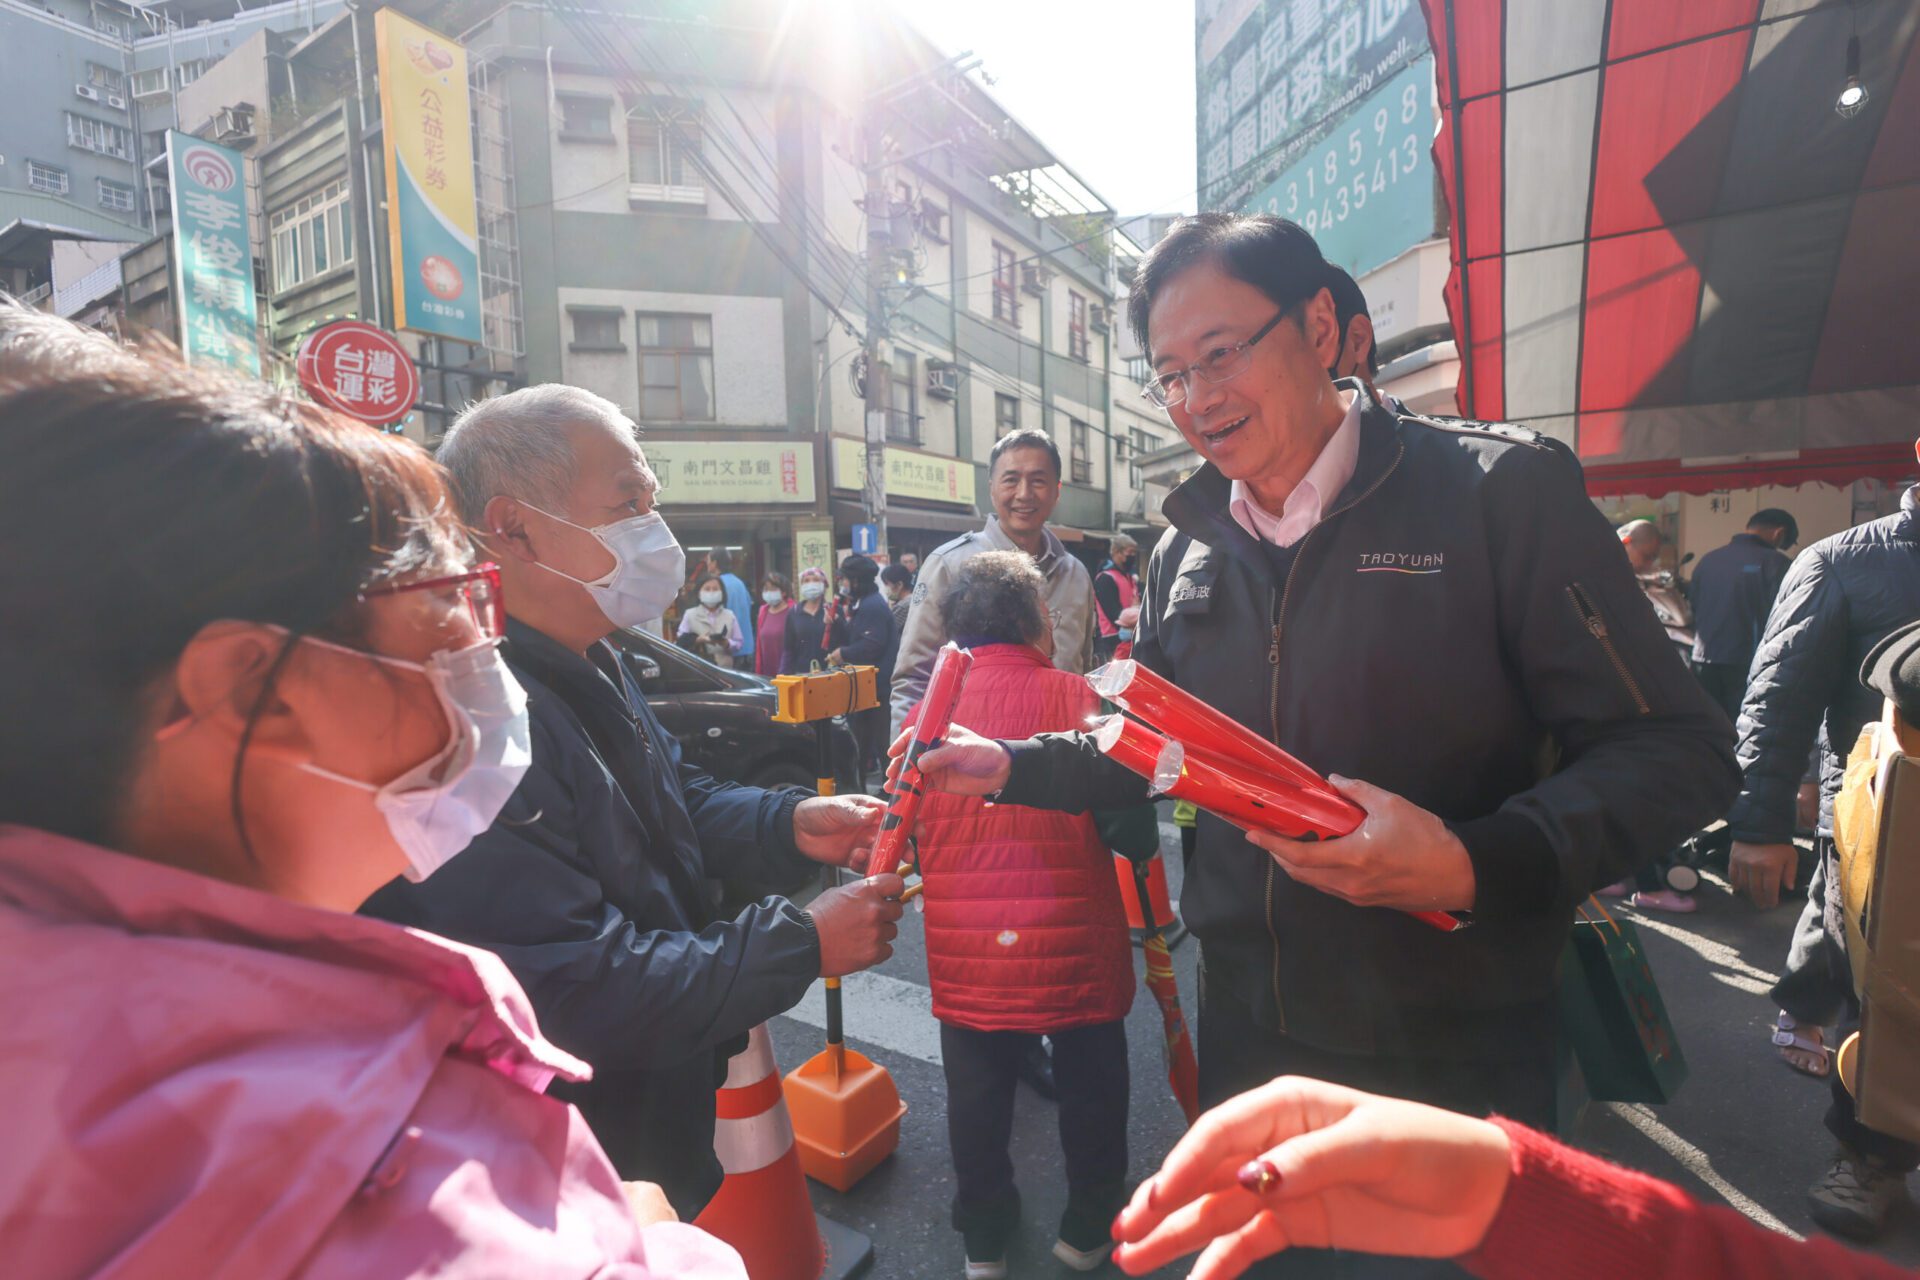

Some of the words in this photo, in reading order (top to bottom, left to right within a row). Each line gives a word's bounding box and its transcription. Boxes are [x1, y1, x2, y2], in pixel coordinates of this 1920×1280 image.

[1205, 0, 1341, 138] 桃園兒童
[1376, 36, 1411, 77] well.
[1296, 134, 1419, 237] 9435413
[334, 343, 396, 379] 台灣
[333, 371, 398, 405] 運彩
[683, 458, 773, 476] 南門文昌雞
[1360, 552, 1444, 567] TAOYUAN
